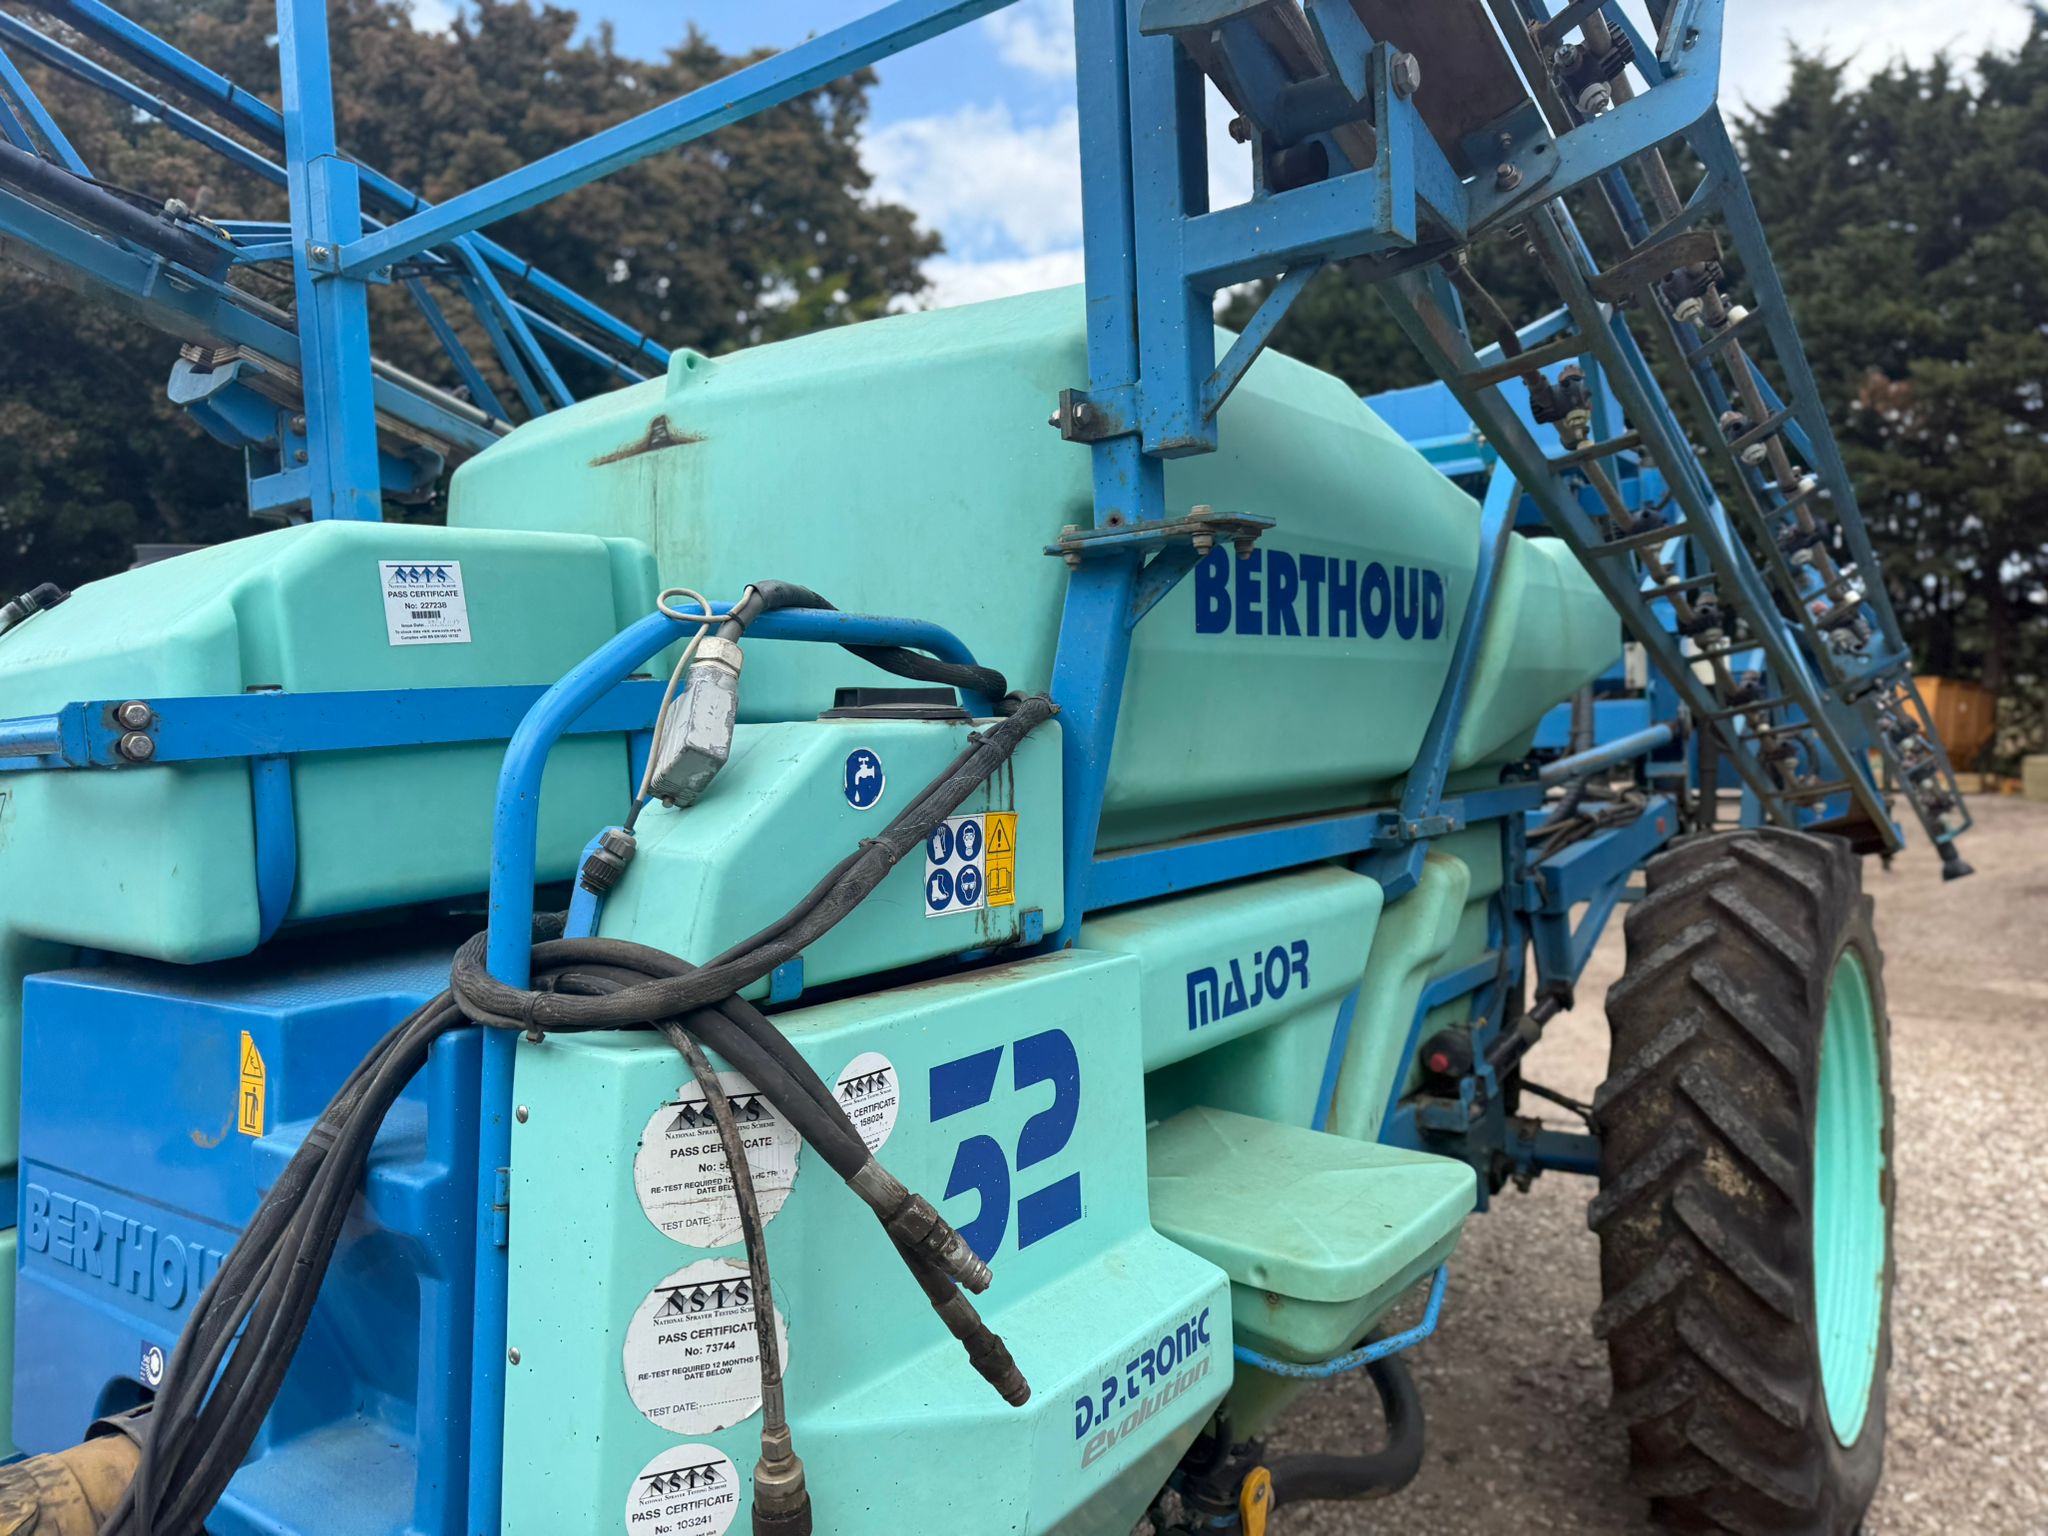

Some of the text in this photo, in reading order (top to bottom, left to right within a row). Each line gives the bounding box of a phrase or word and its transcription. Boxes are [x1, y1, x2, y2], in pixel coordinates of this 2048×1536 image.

[388, 590, 459, 598] PASS CERTIFICATE
[1194, 543, 1444, 641] BERTHOUD
[854, 1096, 896, 1118] CERTIFICATE
[860, 1112, 884, 1127] 158024
[670, 1145, 700, 1159] PASS
[698, 1162, 716, 1173] No:
[651, 1183, 682, 1194] RE-TEST
[684, 1178, 722, 1189] REQUIRED
[696, 1186, 716, 1195] DATE
[661, 1216, 711, 1231] TEST DATE:
[26, 1182, 231, 1312] BERTHOU
[658, 1332, 688, 1345] PASS
[684, 1340, 736, 1357] No: 73744
[638, 1369, 670, 1381] RE-TEST
[672, 1363, 710, 1376] REQUIRED
[722, 1356, 754, 1368] MONTHS
[684, 1367, 733, 1381] DATE BELOW
[648, 1402, 698, 1418] TEST DATE:
[632, 1493, 734, 1523] PASS CERTIFICATE
[654, 1514, 712, 1535] No: 103241
